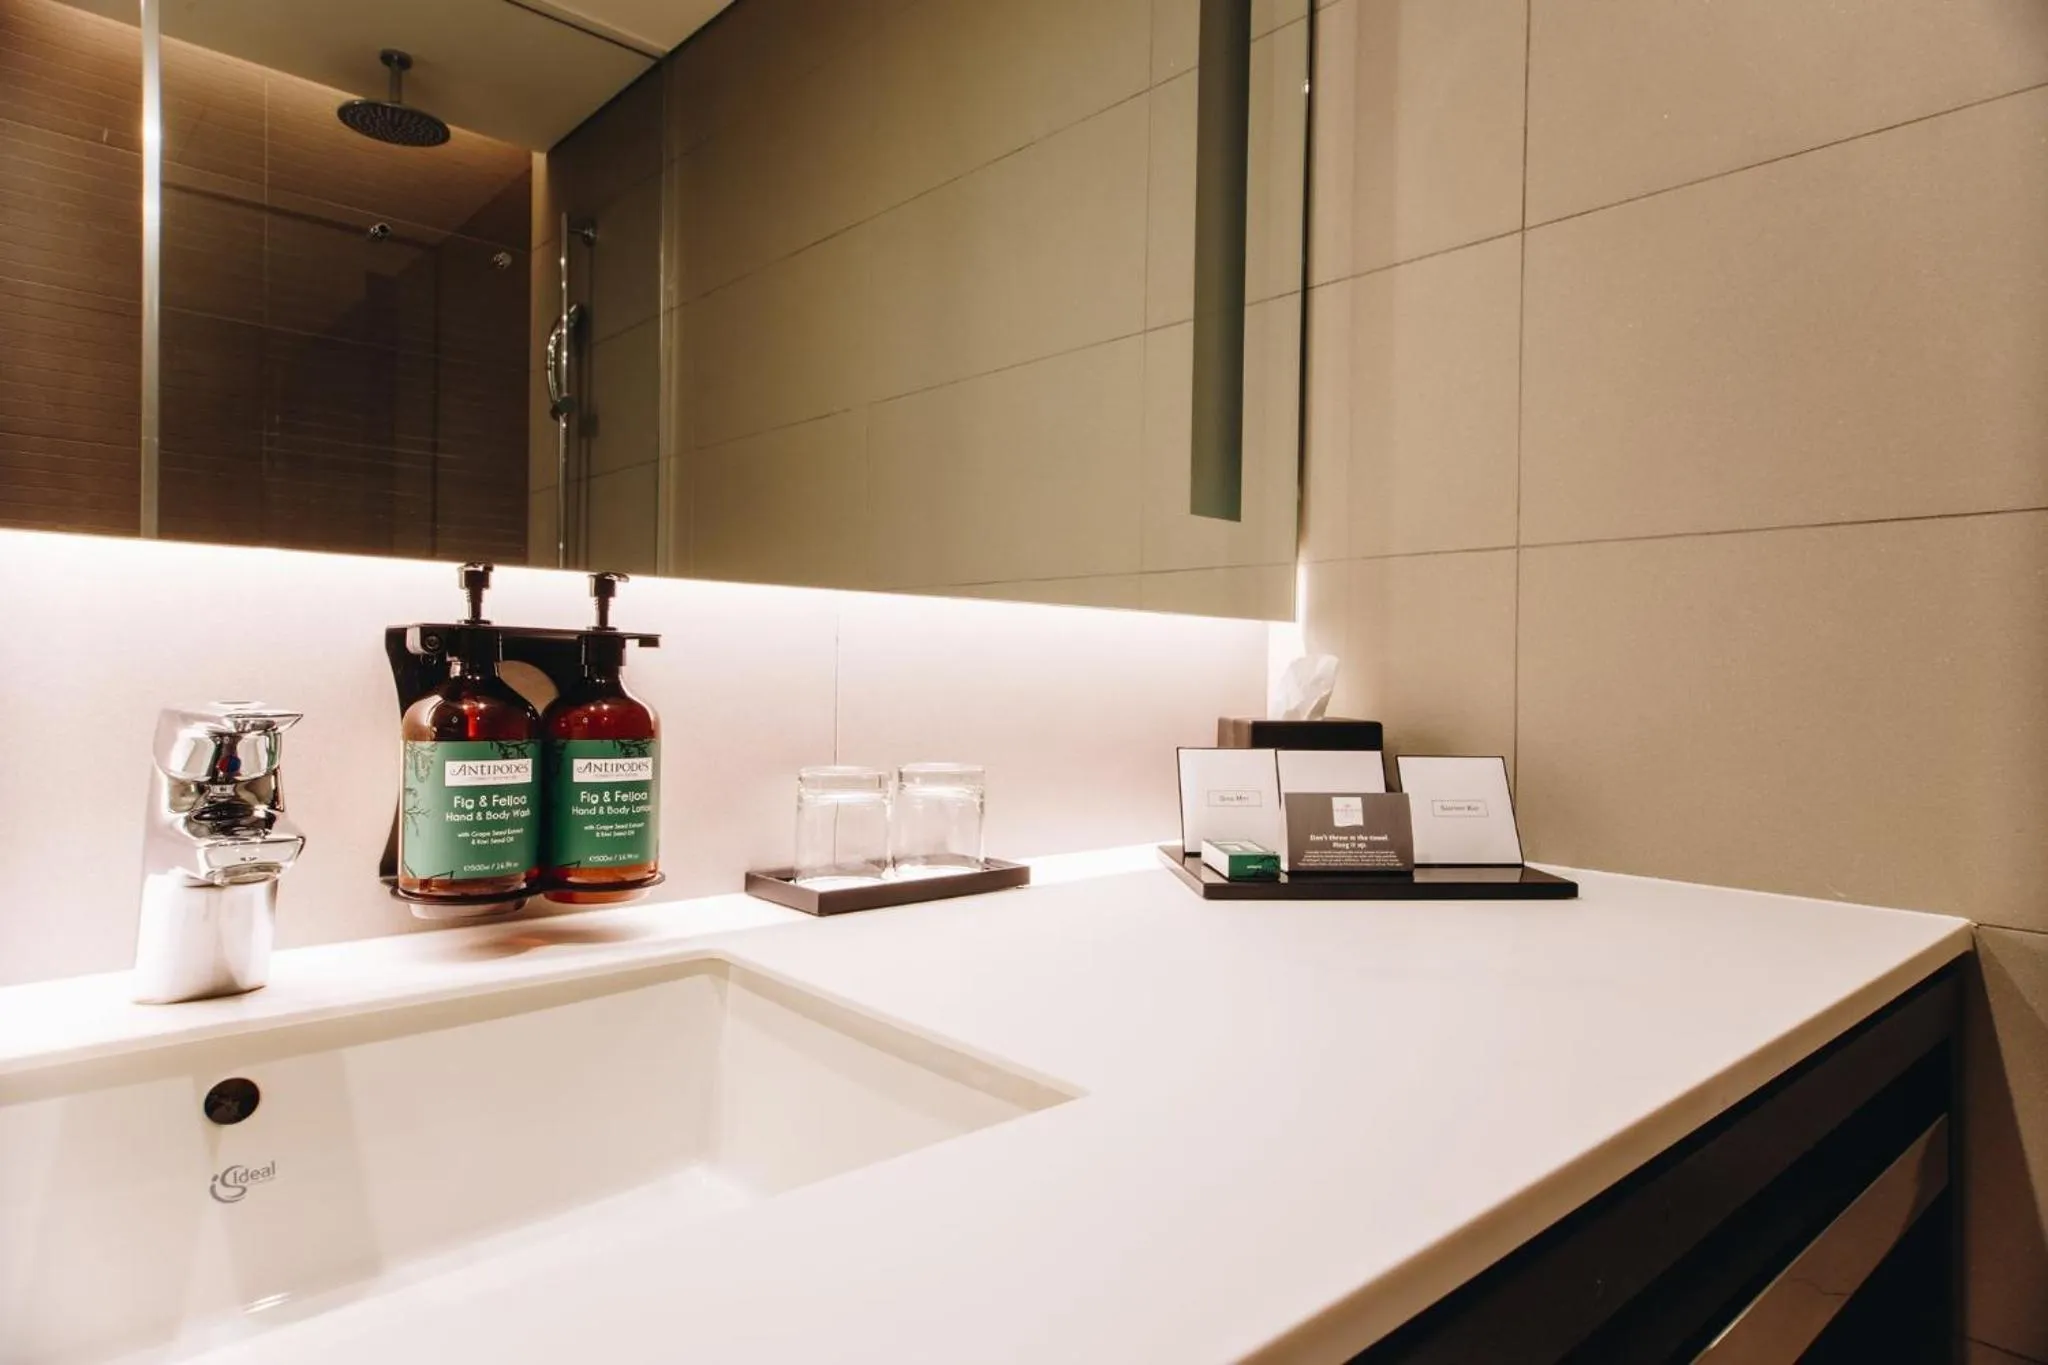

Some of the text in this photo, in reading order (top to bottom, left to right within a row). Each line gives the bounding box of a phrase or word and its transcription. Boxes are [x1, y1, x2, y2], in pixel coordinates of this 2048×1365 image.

[453, 794, 528, 810] Fig & Feijoa
[580, 790, 649, 804] Fig & Feijoa
[445, 811, 474, 822] Hand
[476, 811, 483, 821] &
[485, 809, 511, 821] Body
[571, 805, 597, 816] Hand
[599, 805, 605, 815] &
[607, 804, 630, 815] Body
[1310, 833, 1328, 841] Don't
[1329, 833, 1348, 841] throw
[1357, 833, 1368, 841] the
[1332, 841, 1349, 850] Hang
[232, 1160, 276, 1184] Ideal
